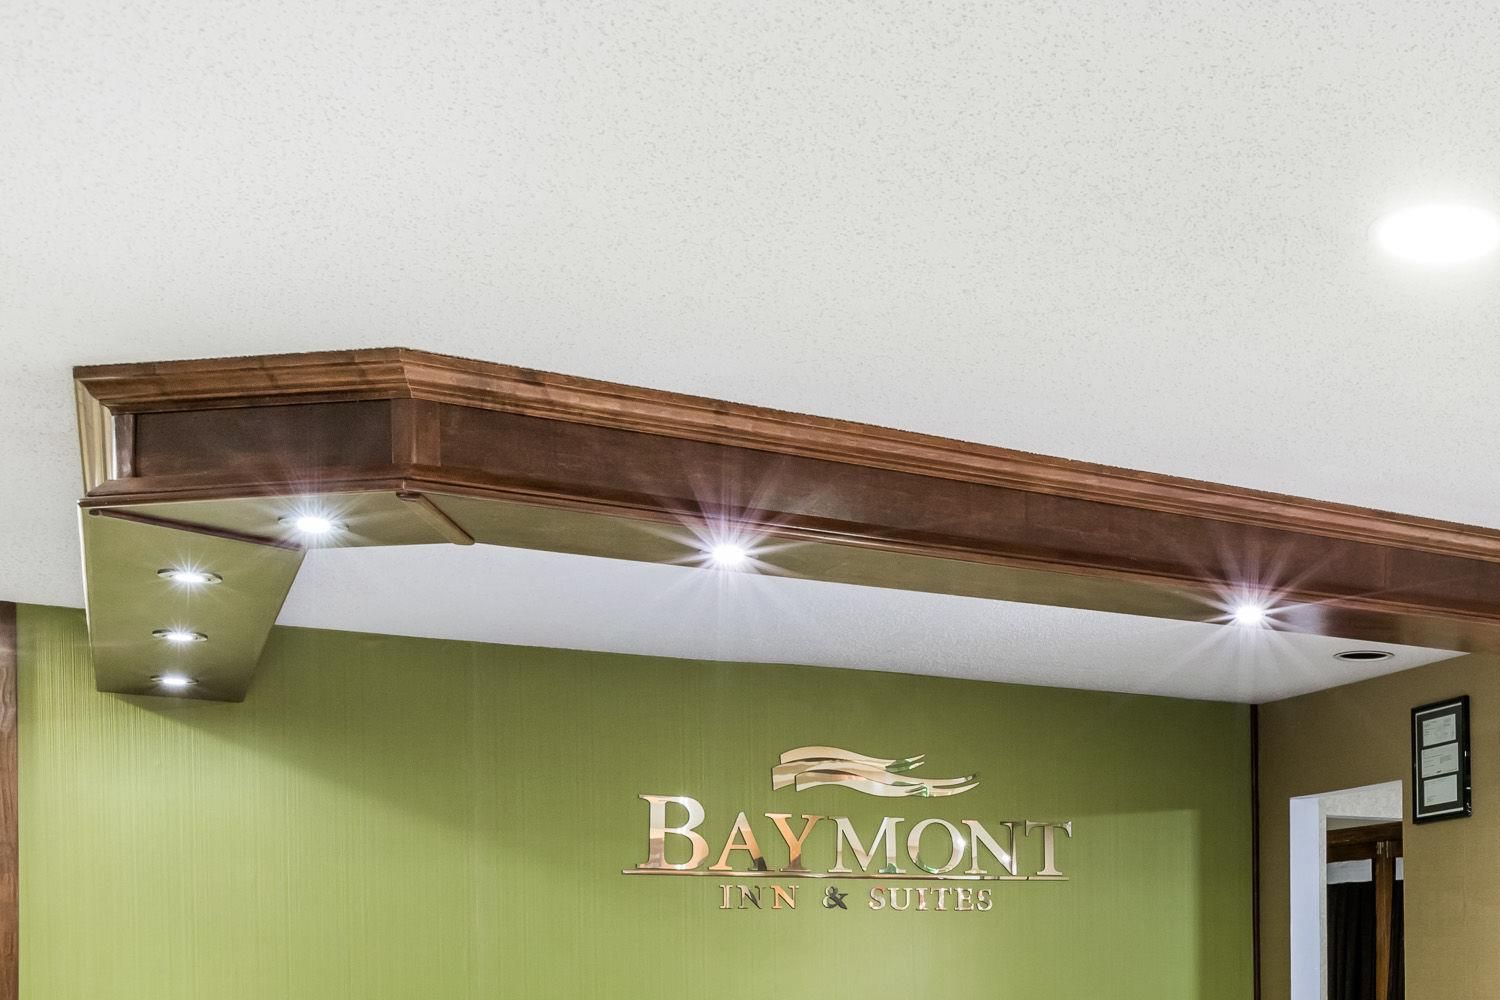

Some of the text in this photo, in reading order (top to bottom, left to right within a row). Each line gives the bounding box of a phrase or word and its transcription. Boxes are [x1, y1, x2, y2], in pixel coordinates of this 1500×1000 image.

[635, 794, 1072, 876] BAYMONT
[718, 885, 993, 911] INN & SUITES
